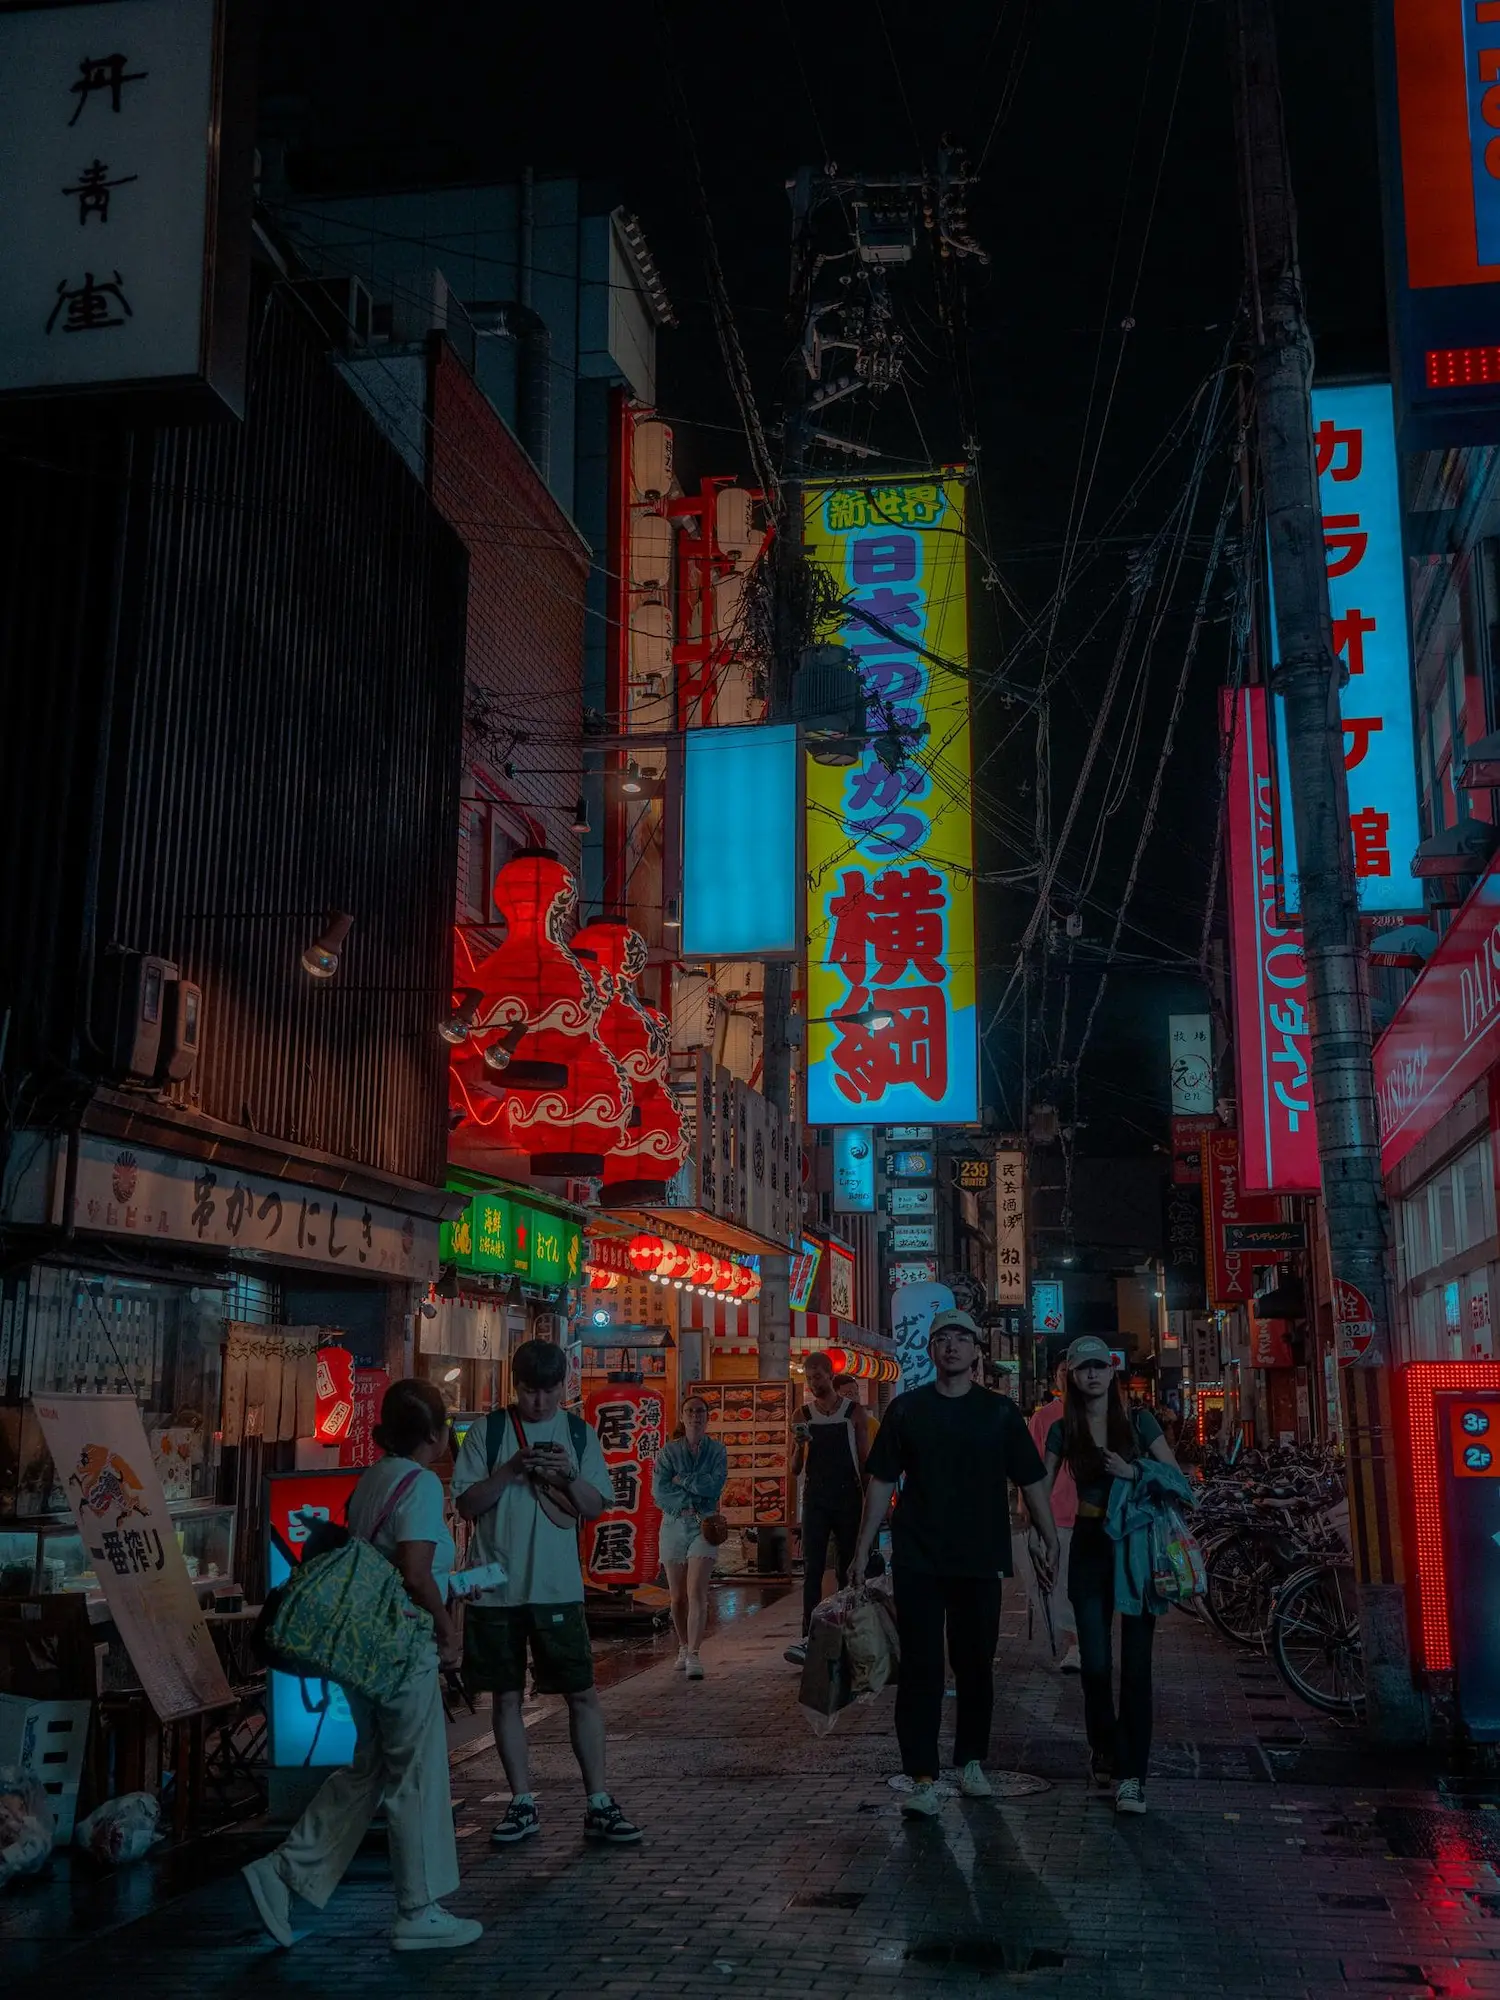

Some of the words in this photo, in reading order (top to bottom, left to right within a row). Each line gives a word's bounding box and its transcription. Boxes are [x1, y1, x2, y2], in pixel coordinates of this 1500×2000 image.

[828, 484, 942, 528] 新世界
[829, 866, 947, 1104] 横綱
[960, 1161, 989, 1176] 238
[191, 1167, 373, 1263] 串かつにしき
[1464, 1413, 1488, 1431] 3F
[1466, 1449, 1490, 1466] 2F
